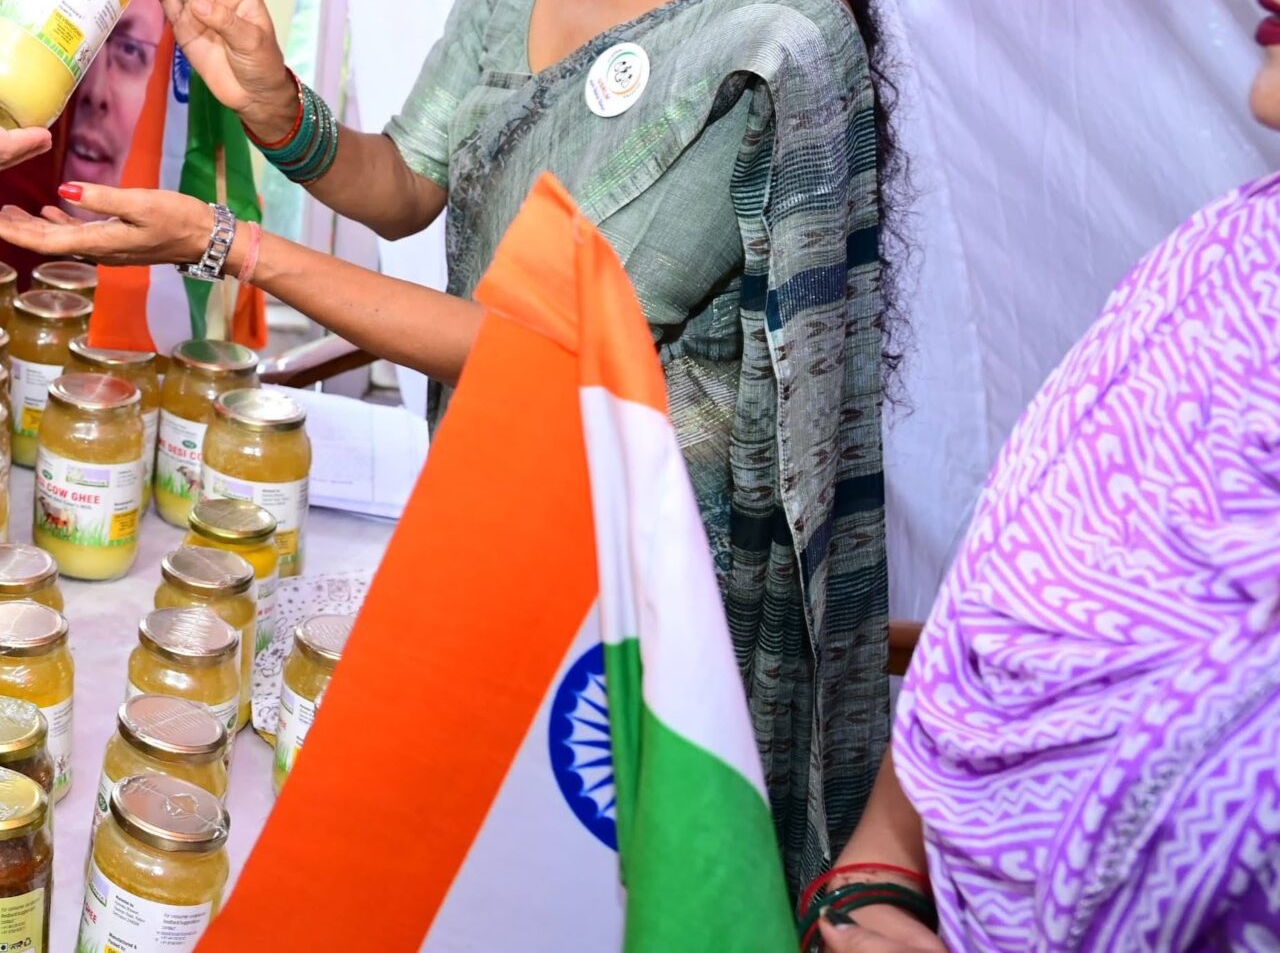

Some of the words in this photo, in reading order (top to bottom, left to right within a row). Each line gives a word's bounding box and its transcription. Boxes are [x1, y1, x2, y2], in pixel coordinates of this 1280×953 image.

[190, 449, 203, 461] CO
[47, 482, 68, 499] COW
[71, 492, 101, 505] GHEE
